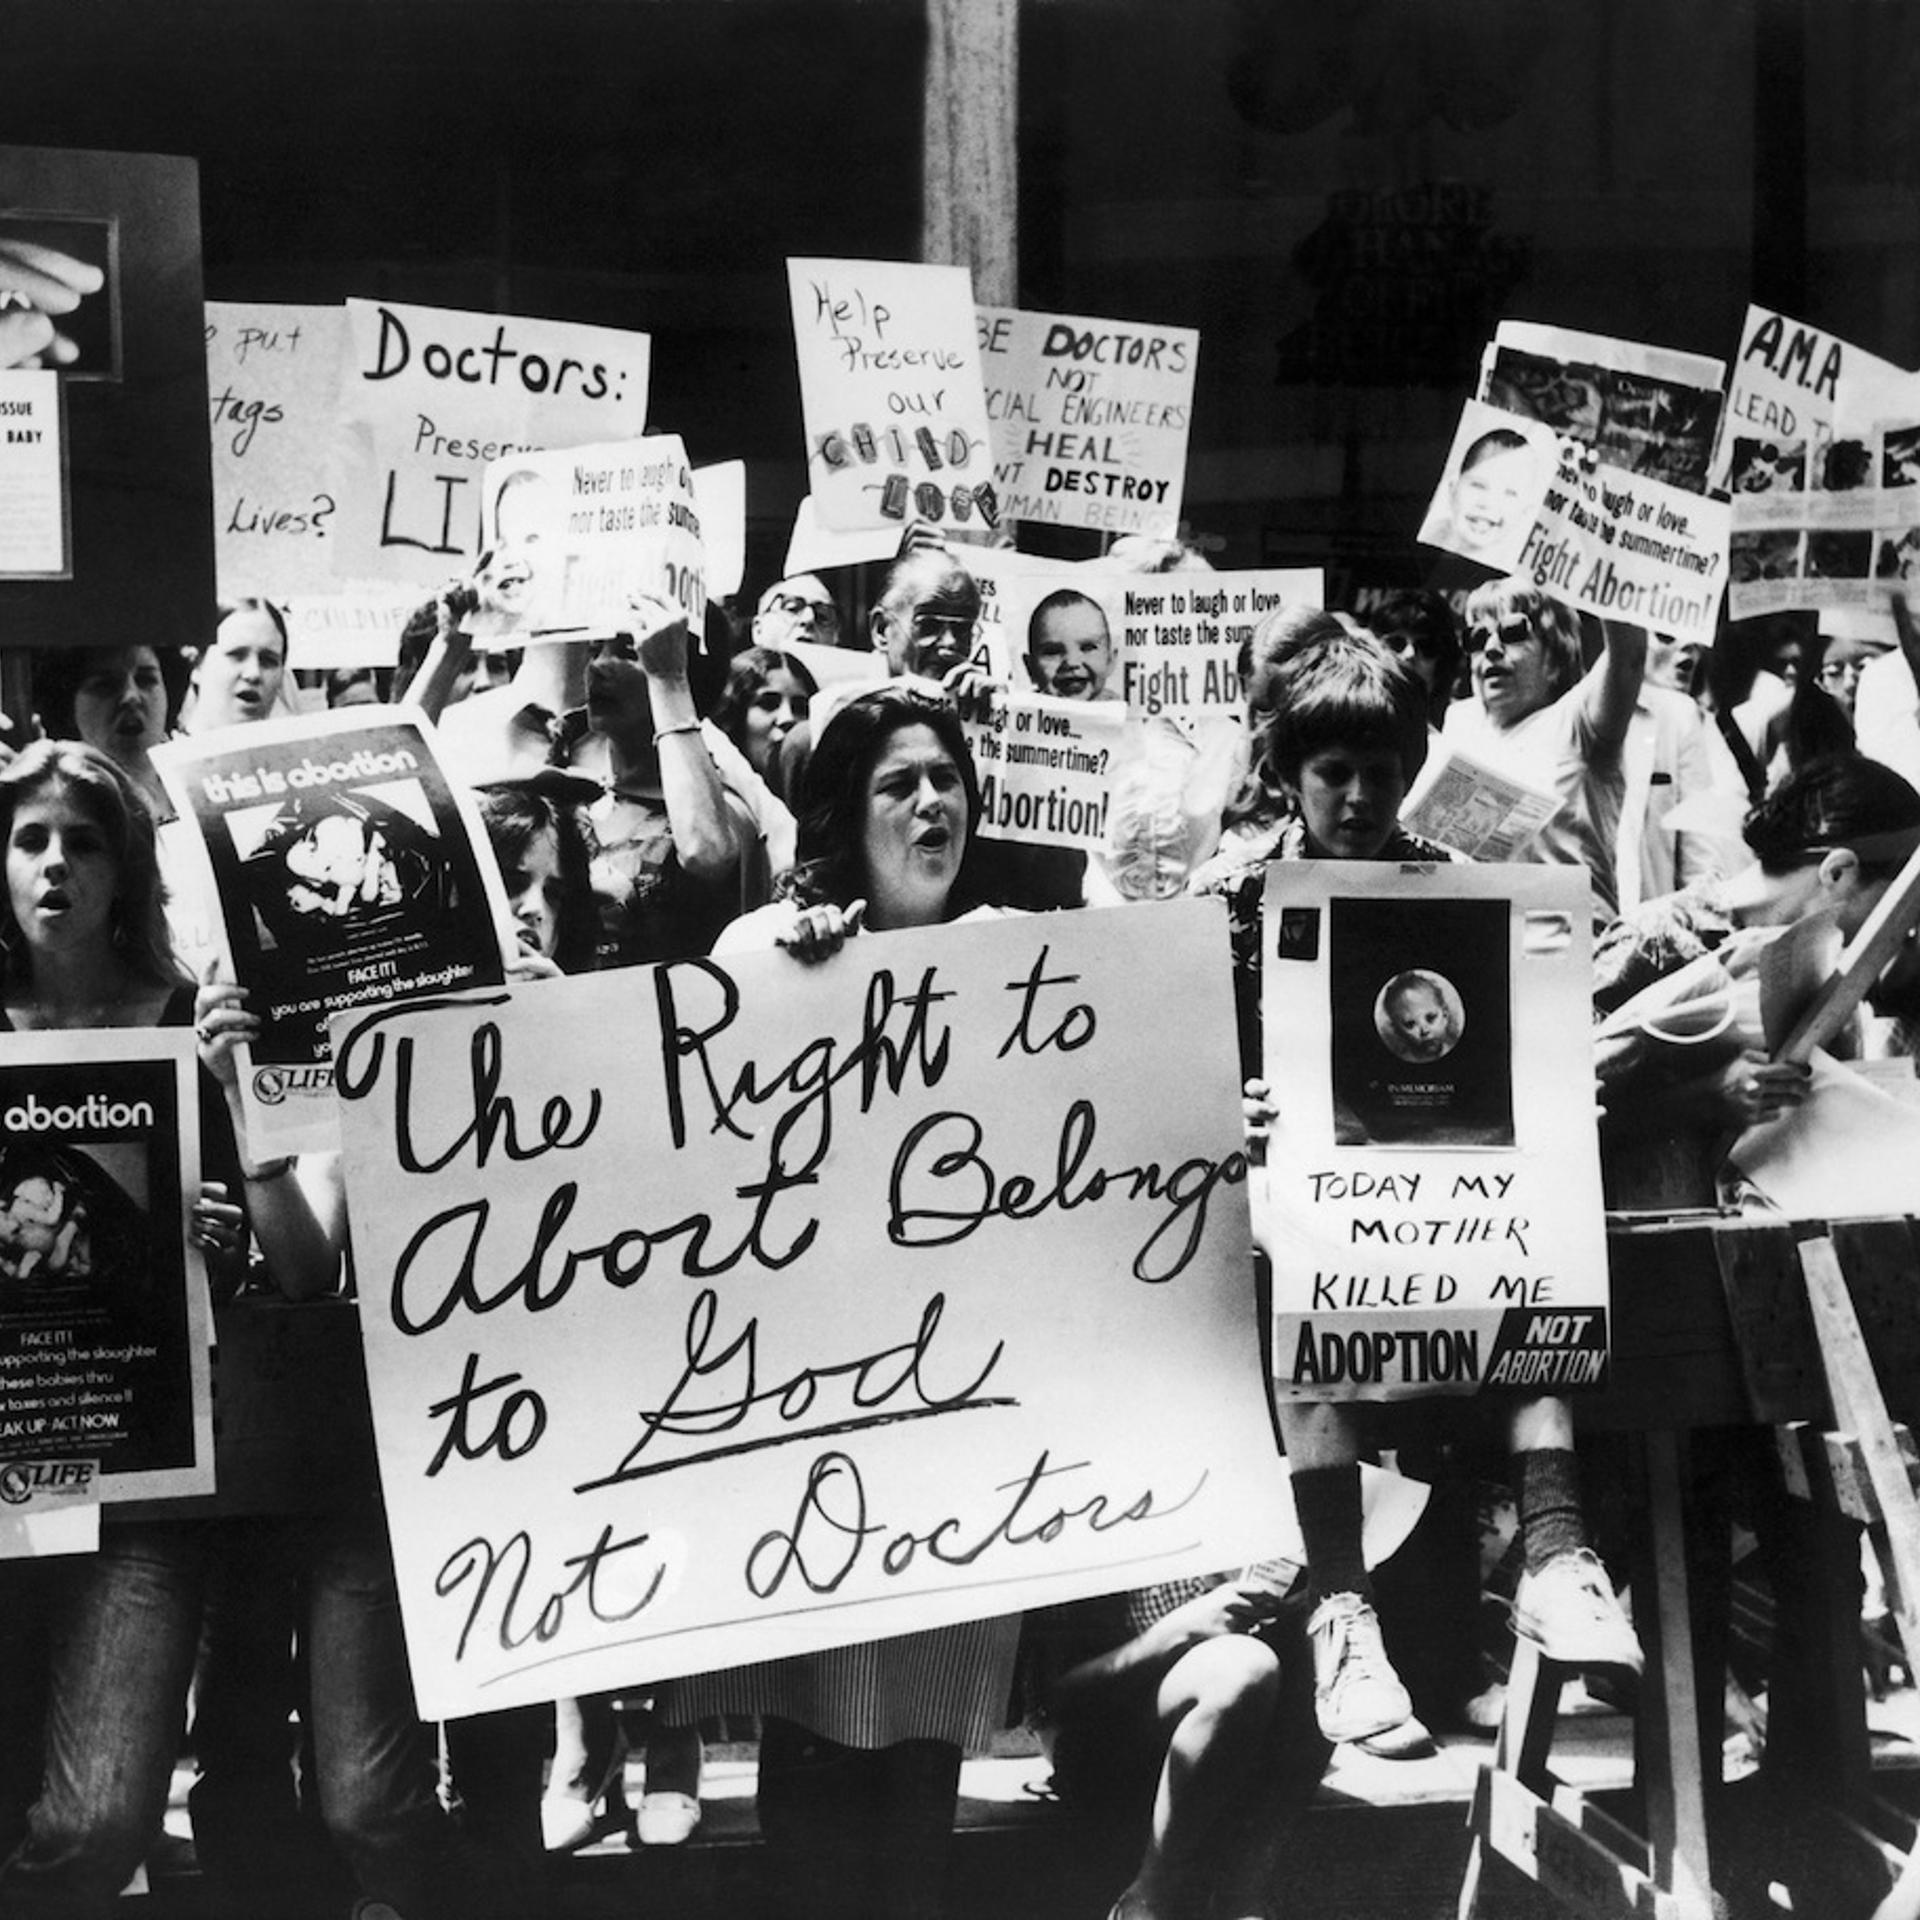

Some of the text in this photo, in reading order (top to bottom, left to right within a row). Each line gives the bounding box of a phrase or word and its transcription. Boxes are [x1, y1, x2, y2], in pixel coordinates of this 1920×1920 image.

[808, 281, 891, 339] Help
[233, 326, 302, 366] put
[362, 307, 627, 401] Doctors:
[830, 335, 965, 372] Preserve
[1042, 324, 1188, 373] DOCTORS
[1046, 367, 1100, 393] NOT
[212, 386, 284, 457] tags
[887, 390, 945, 417] our
[984, 388, 1186, 431] CIAL ENGINEERS
[1734, 388, 1834, 442] LEAD T
[7, 430, 42, 443] BABY
[414, 413, 546, 462] Preser
[1026, 429, 1122, 464] HEAL
[573, 465, 614, 495] Never
[1045, 467, 1170, 504] DESTROY
[227, 494, 336, 538] Lives?
[380, 469, 484, 557] LI
[600, 505, 635, 532] taste
[1637, 500, 1655, 523] or
[1543, 488, 1569, 514] nor
[1619, 529, 1720, 578] summertime?
[1518, 521, 1580, 587] Fight
[1578, 556, 1712, 630] Abortion!
[1125, 591, 1165, 616] Never
[1172, 592, 1186, 614] to
[1189, 588, 1228, 619] laugh
[1233, 594, 1247, 613] or
[1125, 627, 1148, 646] nor
[1154, 624, 1192, 646] taste
[1197, 619, 1219, 645] the
[1124, 659, 1247, 715] Fight Ab
[1016, 711, 1032, 732] or
[201, 749, 418, 803] this is abortion
[1006, 742, 1109, 775] summertime?
[980, 774, 1109, 838] Abortion!
[271, 964, 474, 1021] you are supporting the slaughter
[347, 964, 379, 985] FACE
[312, 1043, 332, 1058] yo
[336, 943, 1097, 1178] The Right to
[4, 1094, 154, 1132] abortion
[1308, 1171, 1516, 1203] TODAY MY
[391, 1101, 1250, 1336] Abort Belongs
[1351, 1218, 1530, 1257] MOTHER
[1312, 1271, 1556, 1310] KILLED ME
[20, 1332, 53, 1346] FACE
[1524, 1315, 1593, 1346] NOT
[67, 1347, 91, 1360] the
[92, 1344, 158, 1363] slaughter
[1292, 1320, 1479, 1385] ADOPTION
[1490, 1348, 1606, 1385] ABORTION
[36, 1372, 84, 1387] babies
[86, 1370, 114, 1384] thru
[427, 1290, 1004, 1477] to God
[8, 1398, 45, 1411] taxes
[48, 1392, 76, 1407] and
[78, 1391, 123, 1406] silence
[52, 1414, 78, 1431] ACT
[80, 1413, 119, 1430] NOW
[33, 1463, 95, 1486] LIFE
[435, 1449, 1209, 1661] Not Doctors
